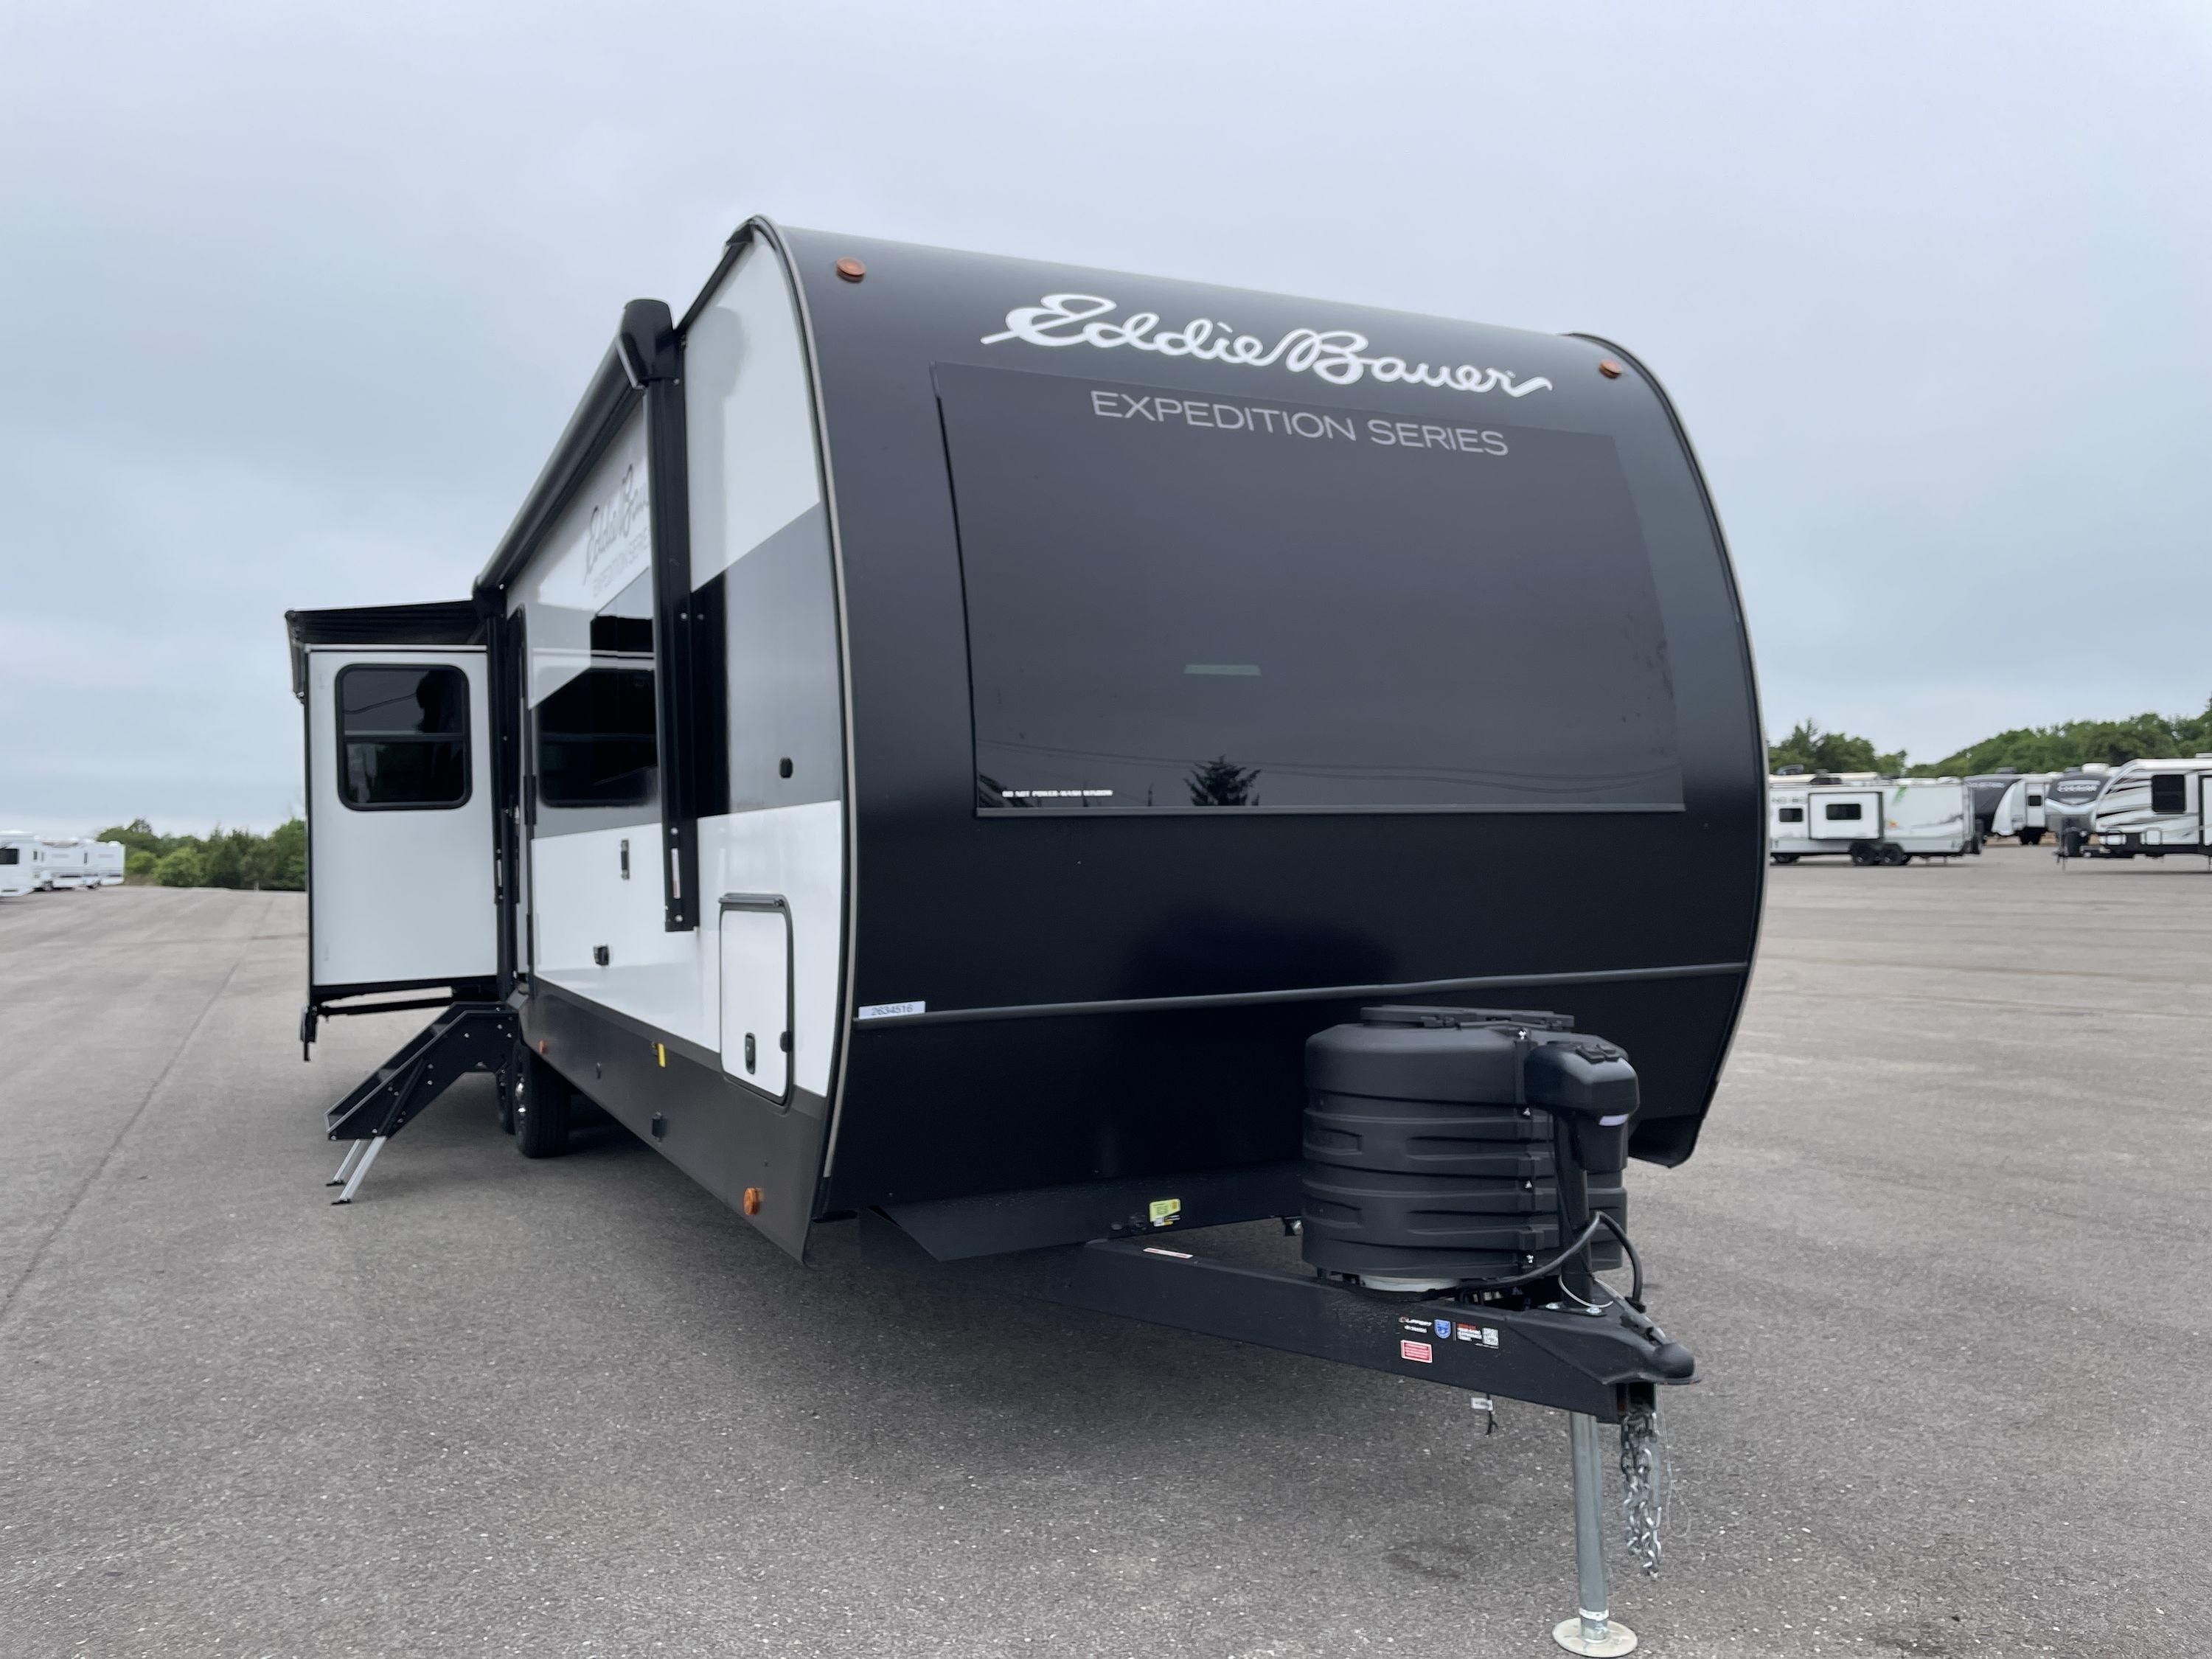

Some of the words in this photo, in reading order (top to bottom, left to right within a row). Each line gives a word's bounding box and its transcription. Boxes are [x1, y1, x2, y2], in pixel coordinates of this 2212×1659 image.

[980, 293, 1277, 366] Eddie
[1270, 328, 1553, 397] Bauer
[1091, 390, 1357, 441] EXPEDITION
[1367, 419, 1509, 456] SERIES
[871, 1004, 914, 1016] 2634516
